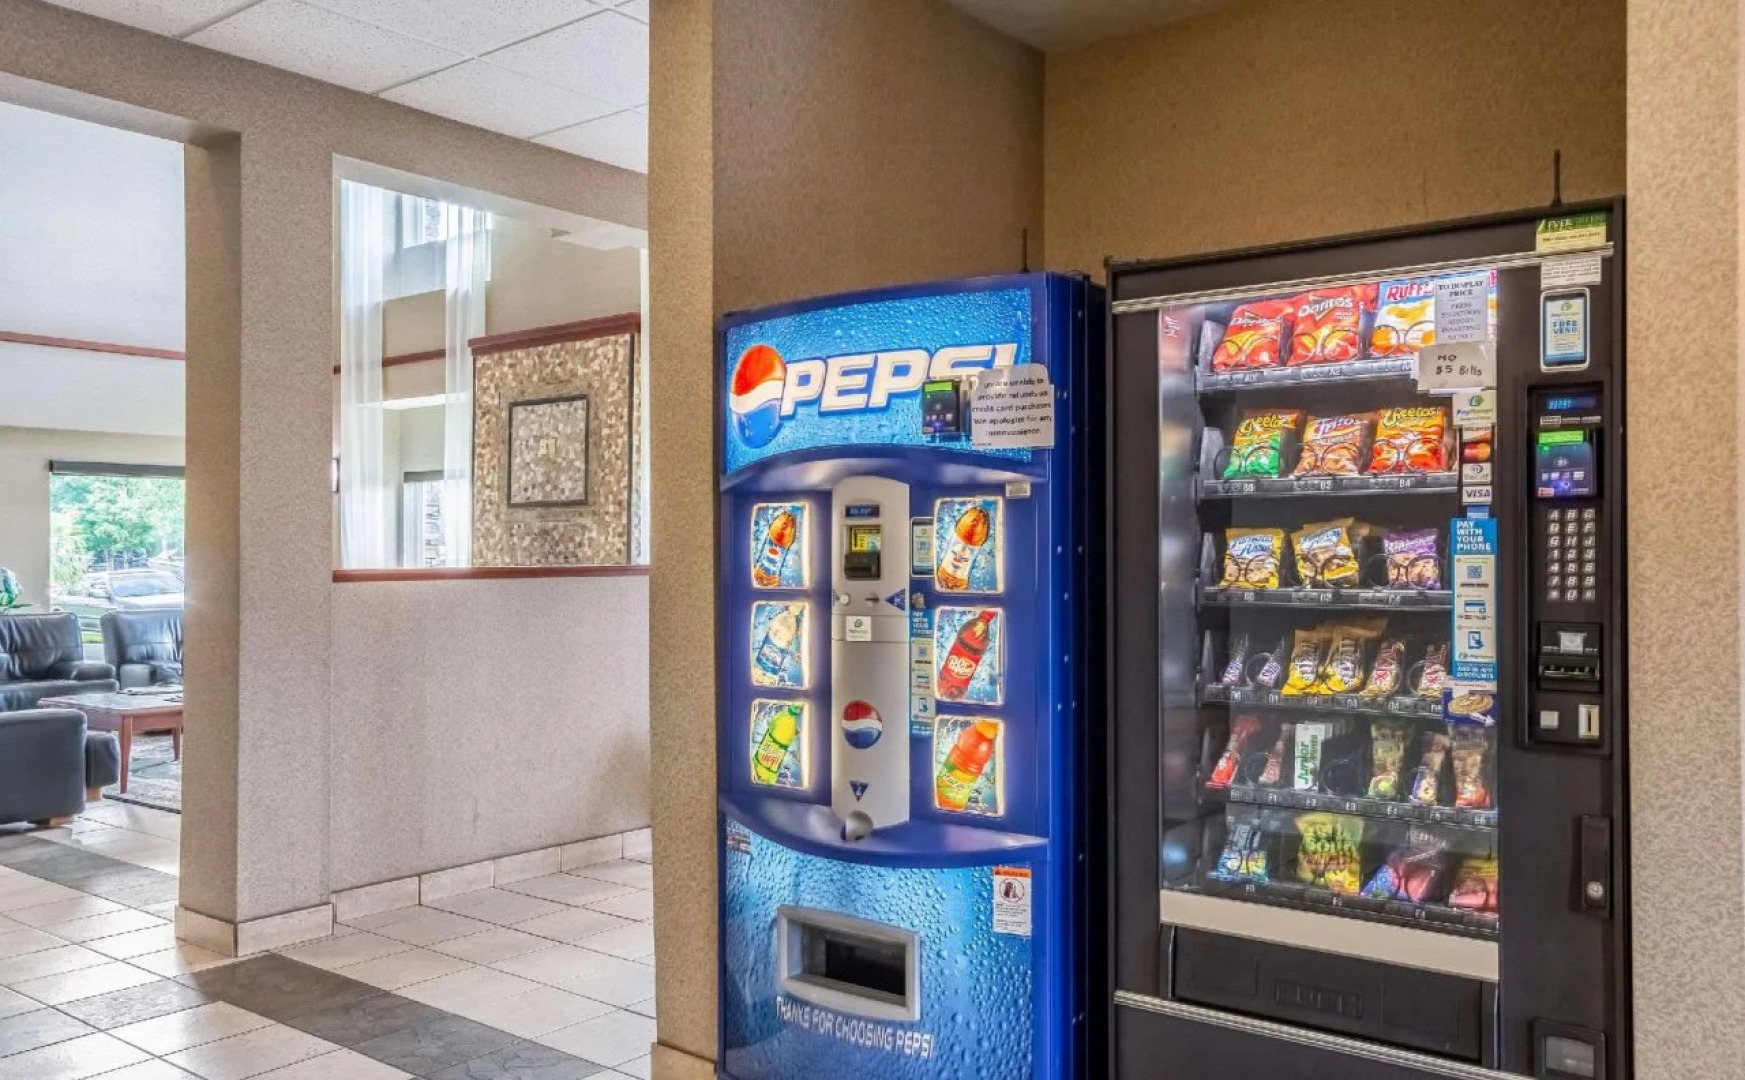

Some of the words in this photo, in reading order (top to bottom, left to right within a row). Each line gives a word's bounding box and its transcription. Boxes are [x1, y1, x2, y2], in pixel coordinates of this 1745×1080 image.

[1449, 289, 1474, 298] PRICE
[1299, 294, 1354, 317] Doritos
[1438, 354, 1457, 362] NO
[996, 404, 1014, 412] card
[1465, 489, 1490, 498] VISA
[1456, 520, 1475, 528] PAY
[1456, 528, 1482, 536] WITH
[1456, 542, 1491, 550] PHONE
[776, 996, 811, 1029] THANKS
[812, 1008, 834, 1036] FOR
[836, 1016, 894, 1050] CHOOSING
[896, 1030, 935, 1059] PEPSI
